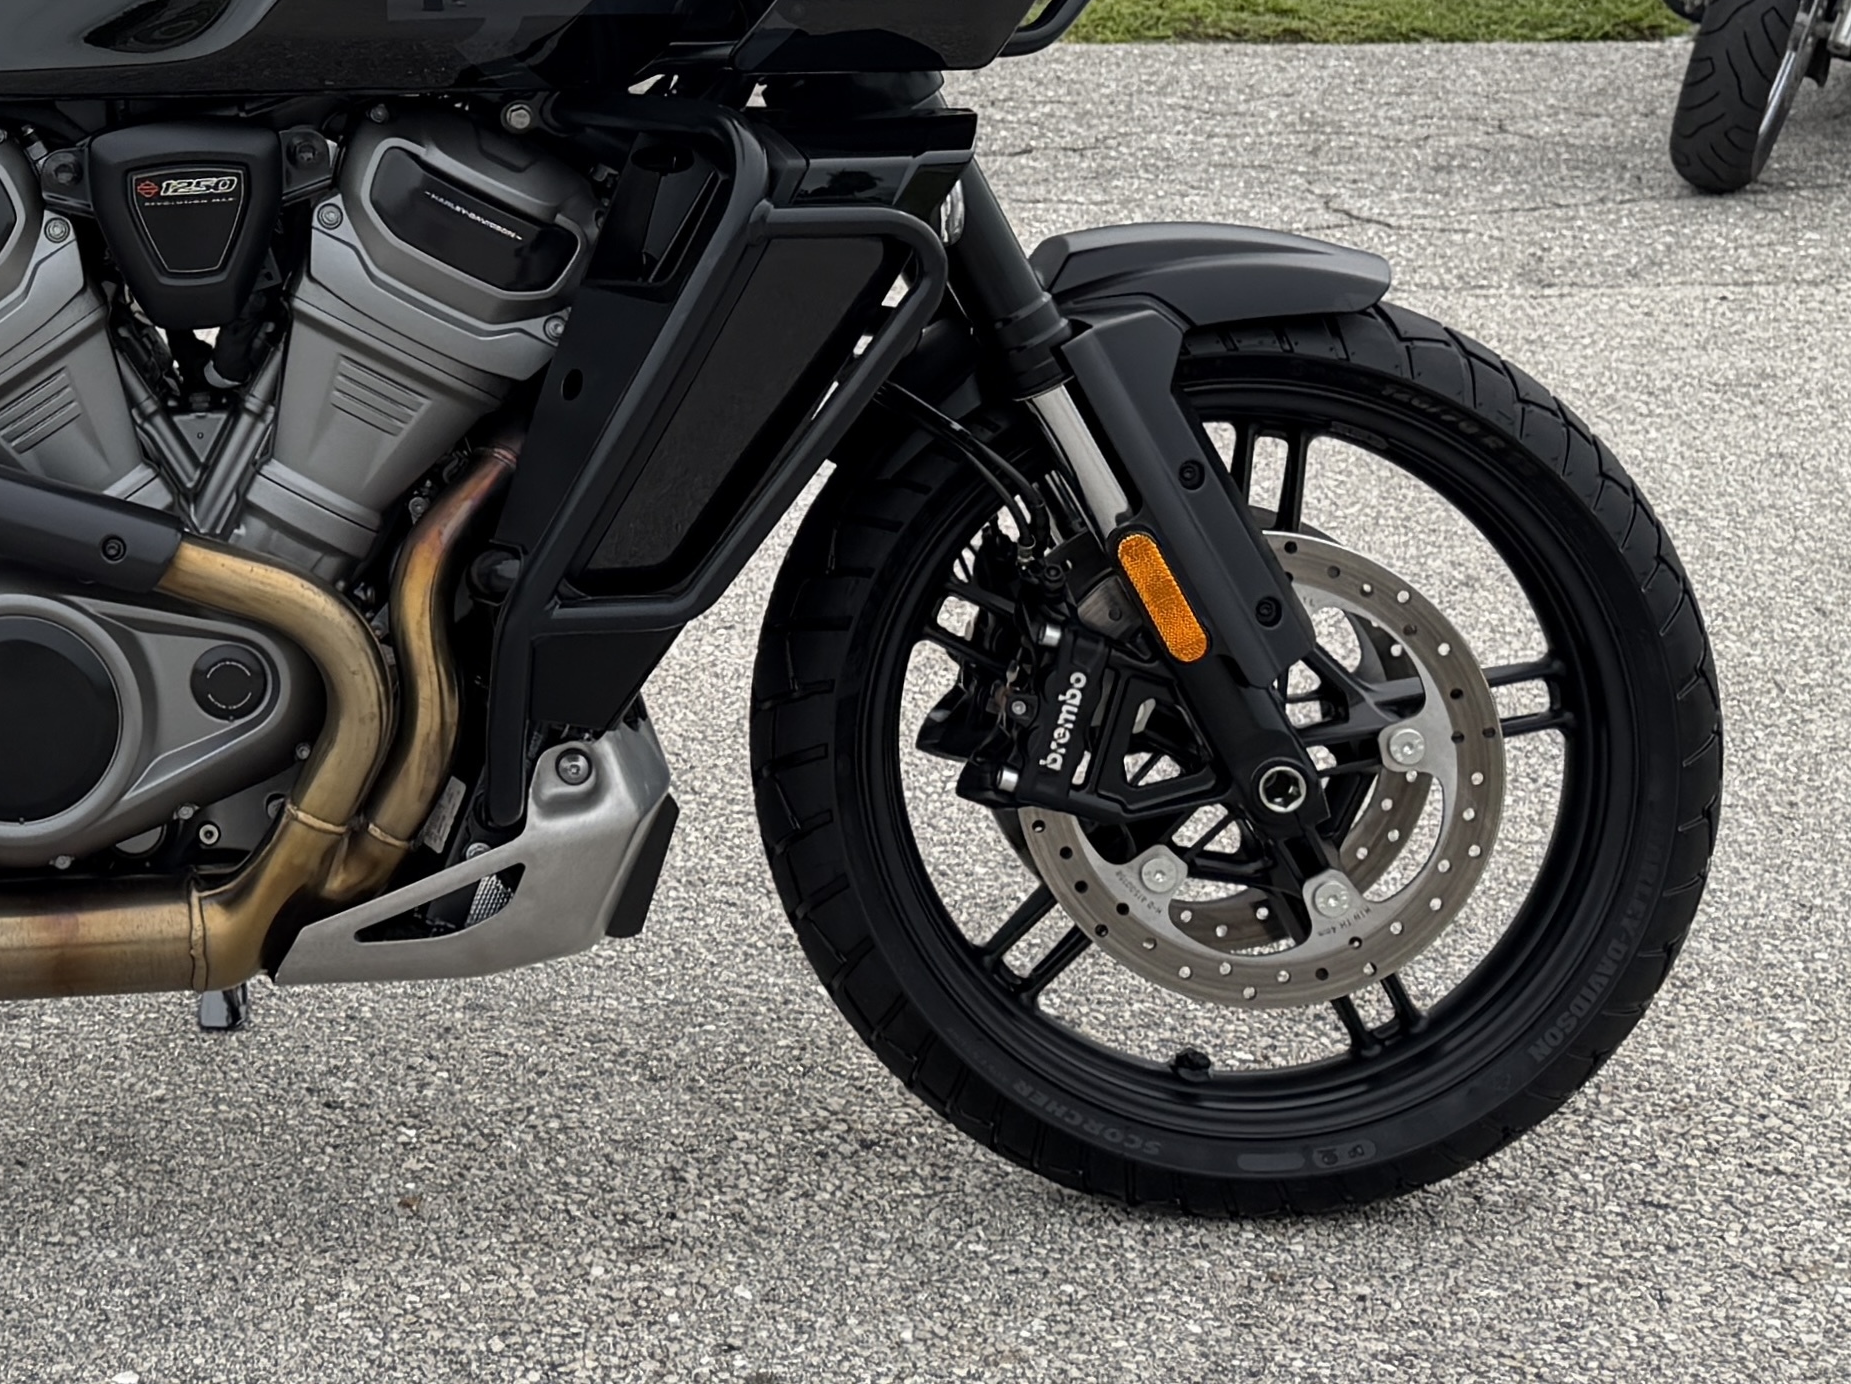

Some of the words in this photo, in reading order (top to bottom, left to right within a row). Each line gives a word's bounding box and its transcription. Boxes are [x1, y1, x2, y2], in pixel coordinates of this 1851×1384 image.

[159, 175, 238, 197] 1250
[1038, 670, 1088, 772] brembo
[1011, 1077, 1162, 1157] SCORCHER
